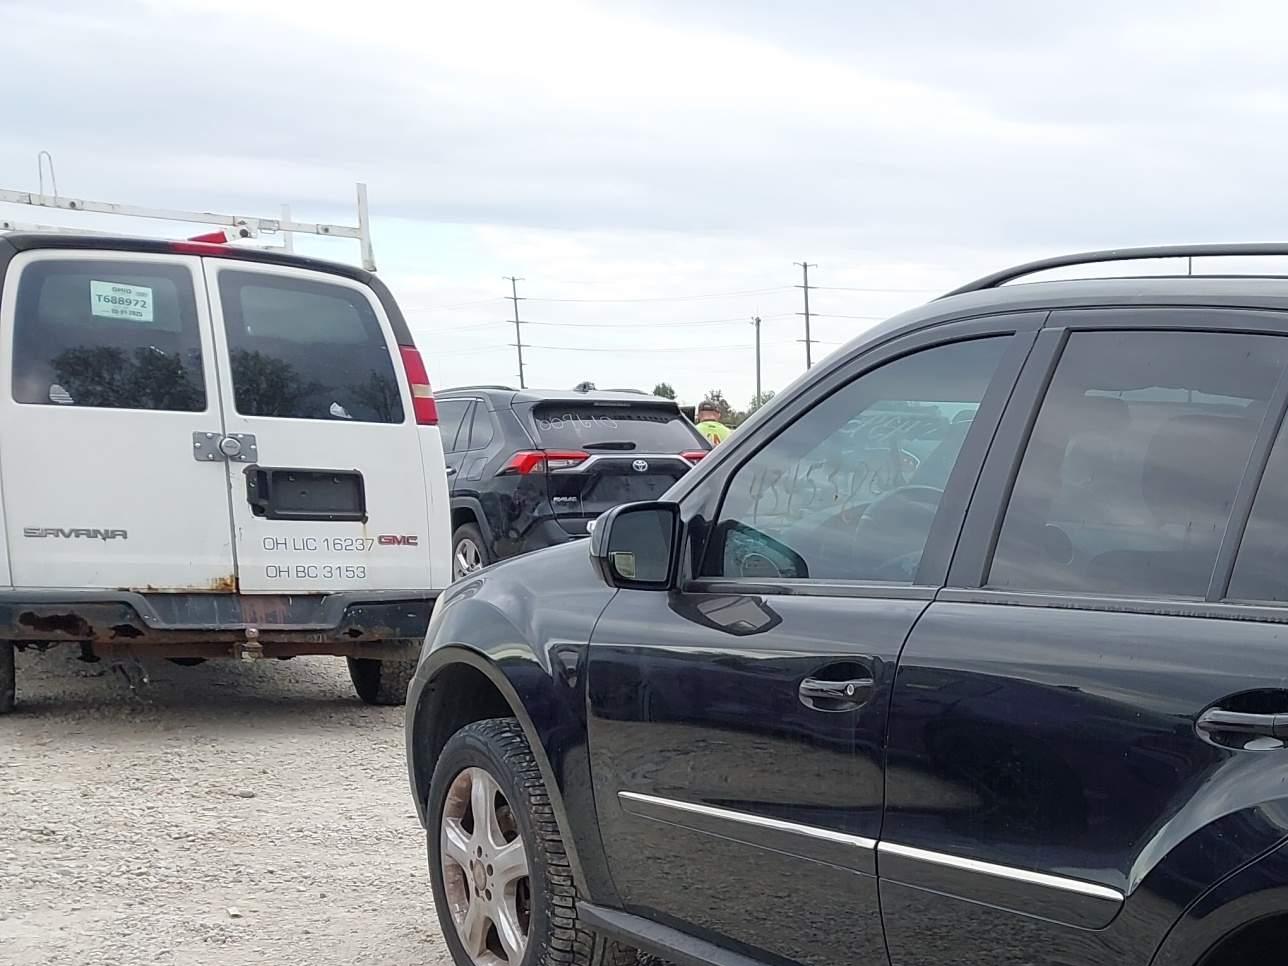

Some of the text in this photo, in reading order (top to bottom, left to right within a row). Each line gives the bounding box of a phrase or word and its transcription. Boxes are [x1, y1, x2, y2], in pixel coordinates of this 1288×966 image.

[95, 294, 148, 309] T688972
[23, 527, 128, 541] SAVANA
[378, 534, 418, 546] GMC
[263, 537, 375, 551] OH LIC 16237
[265, 565, 367, 579] OH BC 3153
